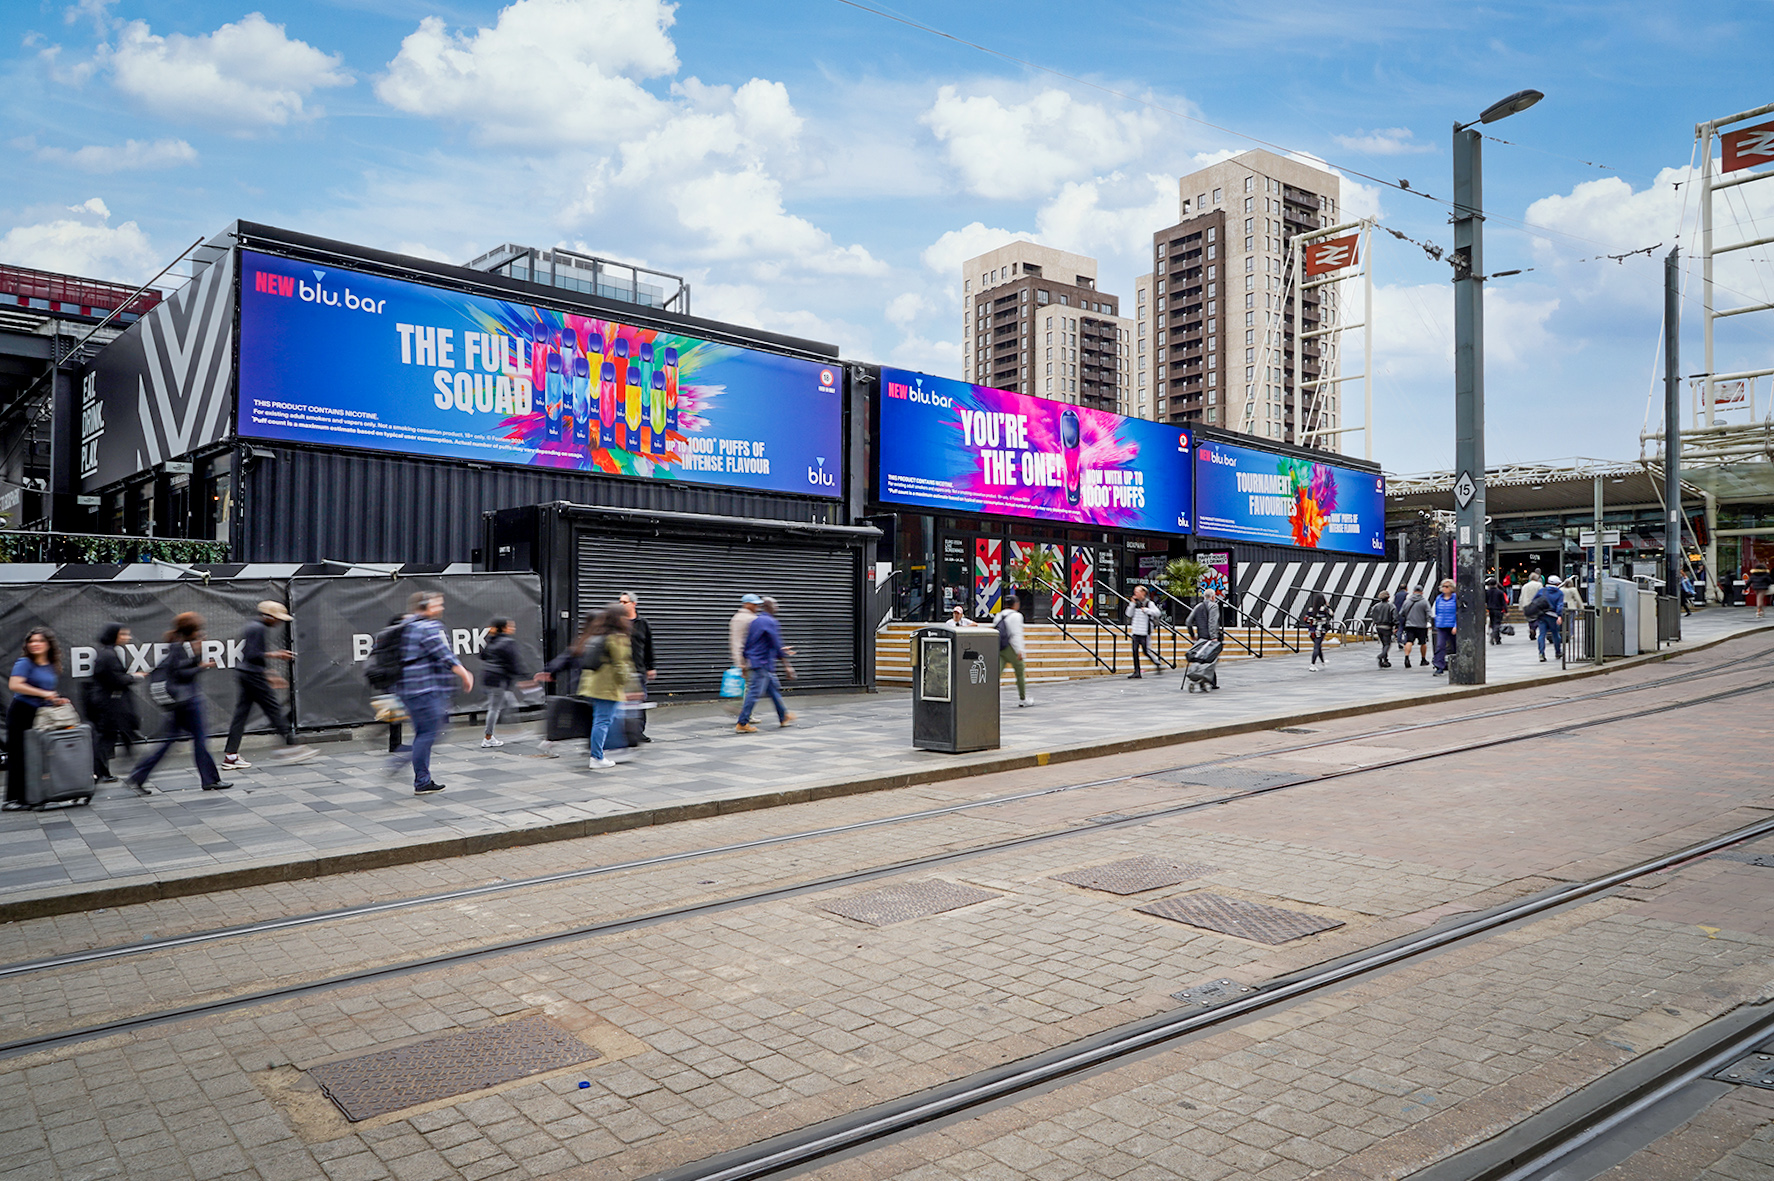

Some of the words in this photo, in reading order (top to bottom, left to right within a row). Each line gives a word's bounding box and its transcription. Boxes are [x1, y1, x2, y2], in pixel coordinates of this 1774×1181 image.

[256, 271, 294, 298] NEW
[396, 323, 455, 368] THE
[464, 331, 533, 376] FULL
[434, 370, 533, 415] SQUAD
[888, 382, 908, 400] NEW
[253, 399, 270, 407] THIS
[272, 401, 307, 411] PRODUCT
[308, 405, 344, 416] CONTAINS
[264, 409, 288, 418] existing
[306, 414, 331, 423] smokers
[344, 418, 362, 426] vapers
[393, 424, 416, 432] smoking
[298, 421, 329, 430] maximum
[330, 424, 356, 433] estimate
[384, 431, 403, 439] typical
[960, 410, 1028, 449] YOU'RE
[666, 440, 676, 452] UP
[678, 441, 686, 452] TO
[719, 439, 750, 456] PUFFS
[752, 441, 764, 457] OF
[682, 453, 724, 472] INTENSE
[726, 456, 770, 474] FLAVOUR
[981, 450, 1016, 486] THE
[1022, 452, 1062, 486] ONE!
[1086, 469, 1103, 484] NOW
[1104, 470, 1122, 484] WITH
[1124, 470, 1134, 485] UP
[1134, 471, 1144, 486] TO
[1236, 472, 1292, 494] TOURNAMENT
[1113, 486, 1145, 508] PUFFS
[1459, 484, 1470, 496] 15
[1249, 495, 1297, 516] FAVOURITES
[71, 639, 246, 678] BXPRK
